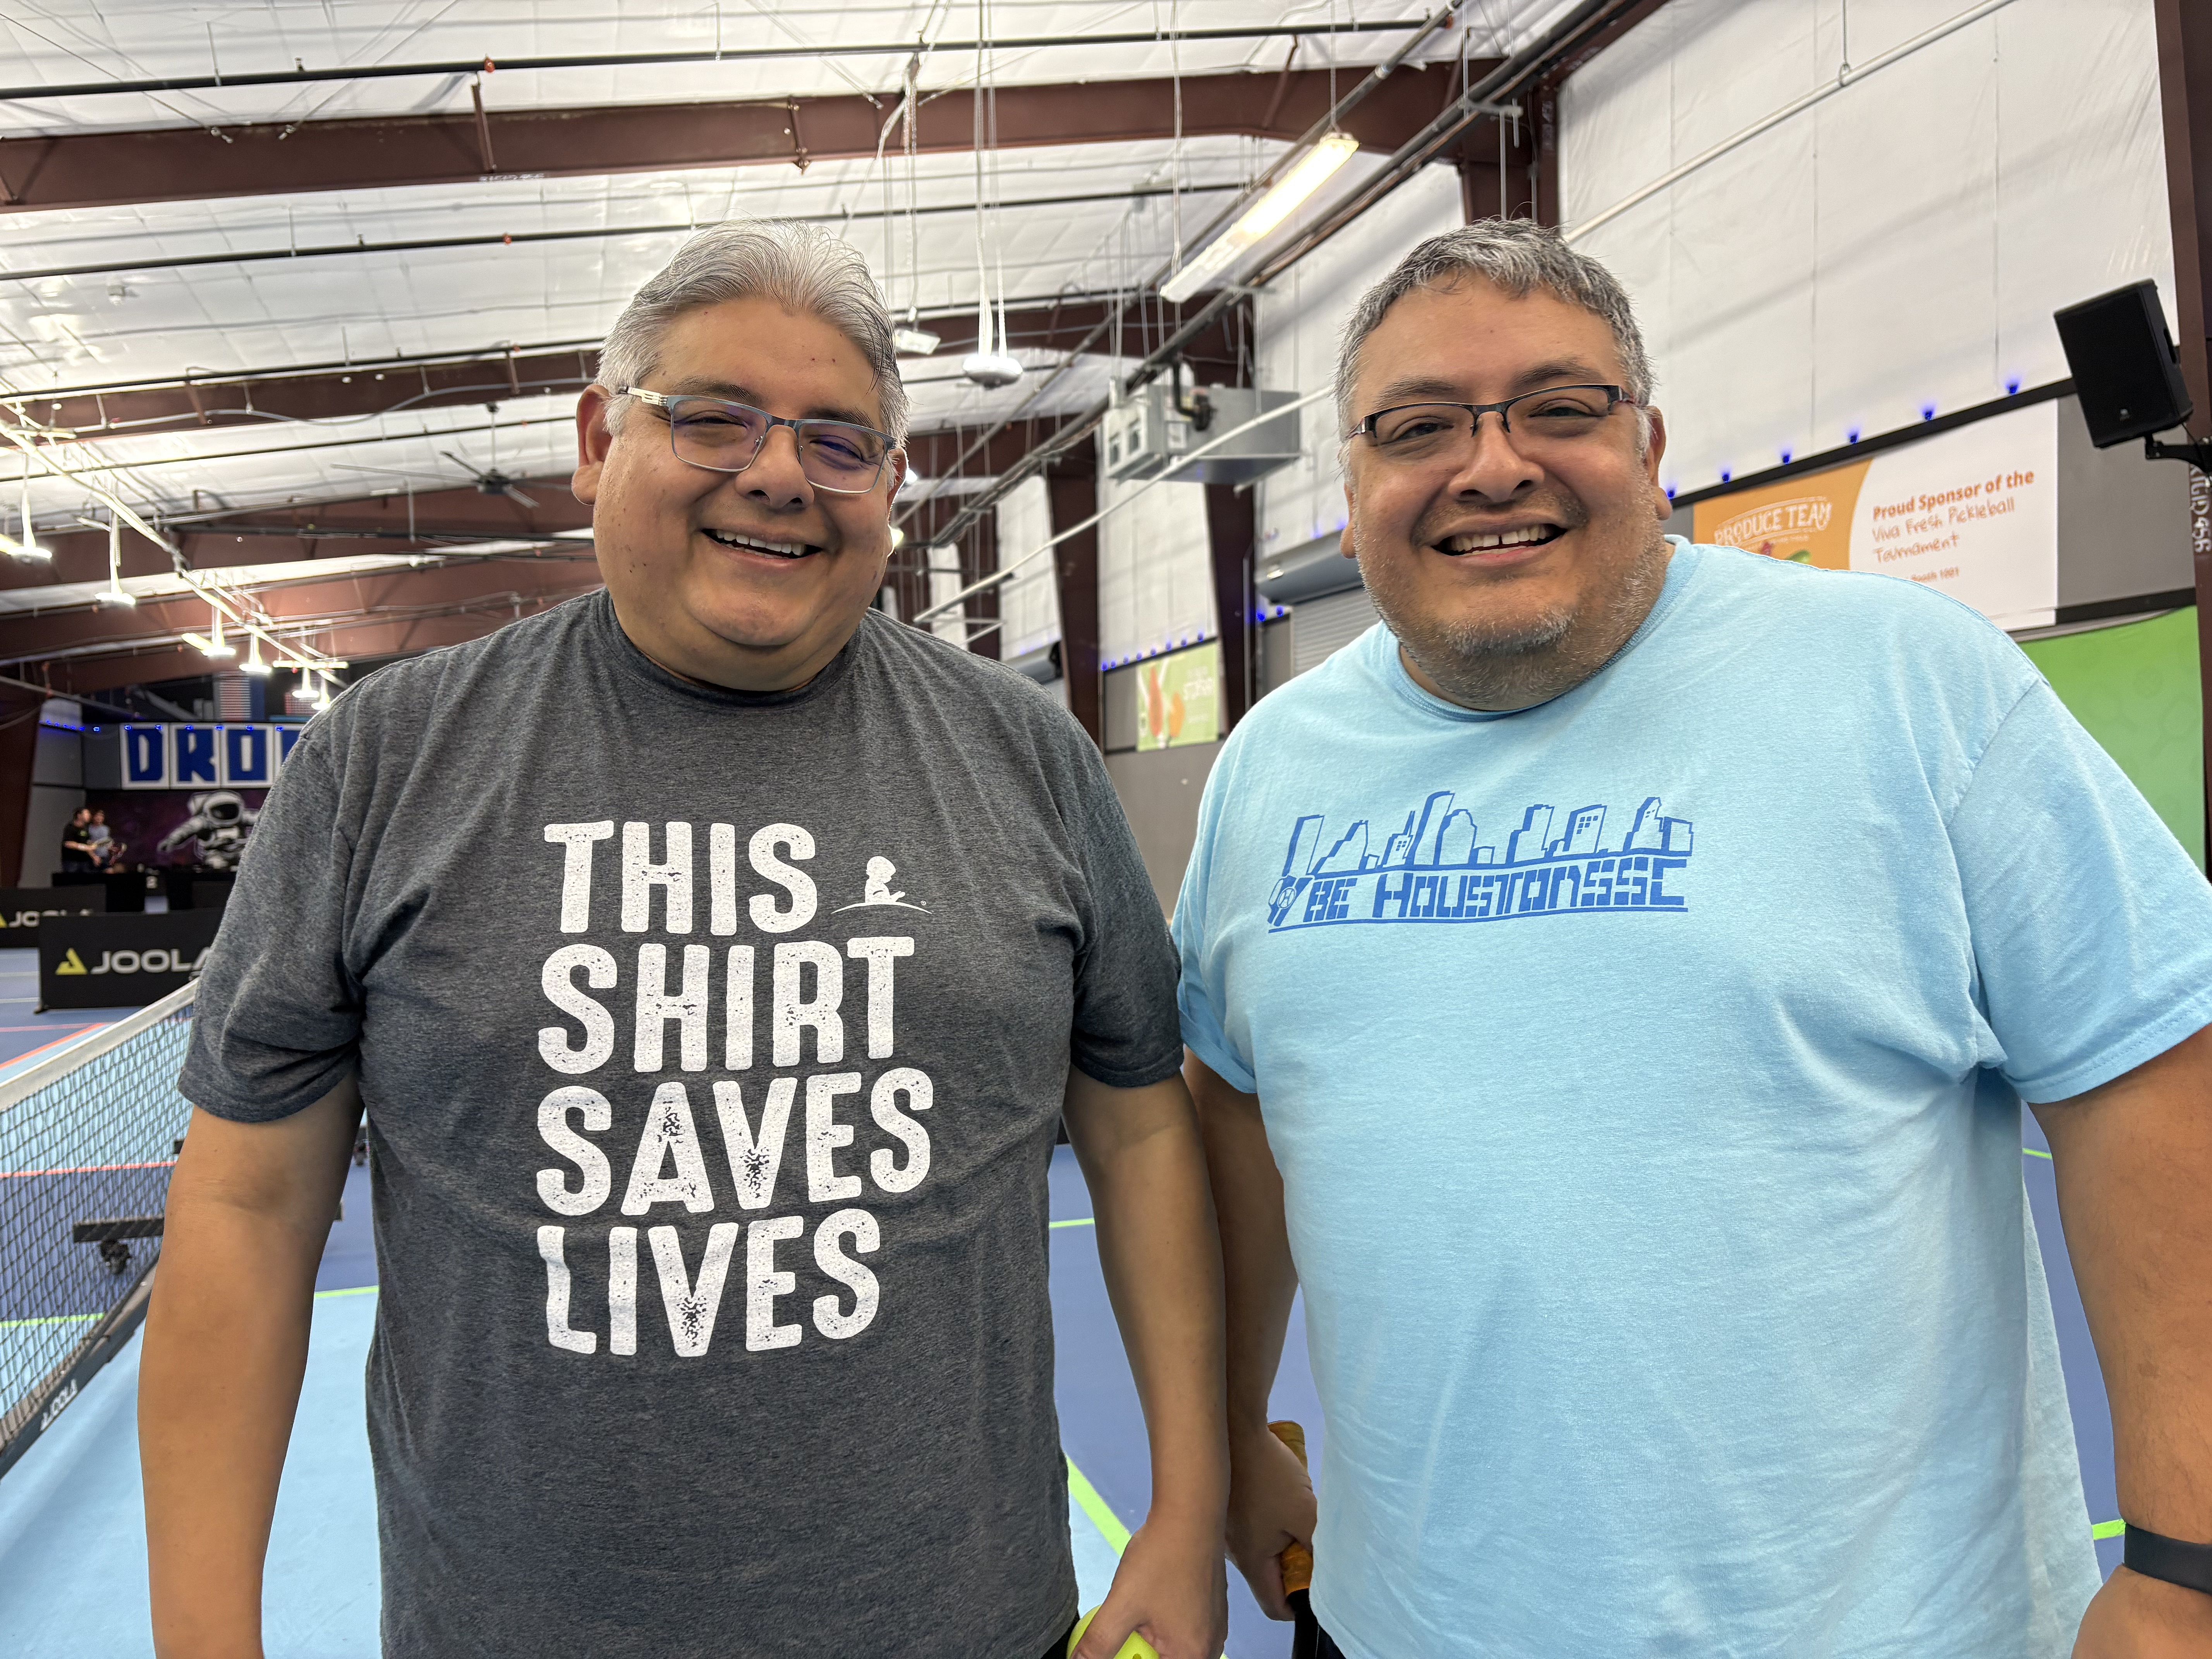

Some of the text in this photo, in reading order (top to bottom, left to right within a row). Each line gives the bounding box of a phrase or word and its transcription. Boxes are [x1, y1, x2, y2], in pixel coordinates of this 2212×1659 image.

[1872, 497, 2014, 542] Viva Fresh Pickleball
[1873, 471, 2034, 520] Proud Sponsor of the
[1714, 508, 1782, 545] PRODUCE
[1786, 502, 1832, 531] TEAM
[2192, 517, 2212, 553] 456
[127, 728, 301, 781] DRO
[544, 821, 817, 935] THIS
[1303, 878, 1357, 922] BE
[538, 936, 914, 1073] SHIRT
[536, 1067, 933, 1216] SAVES
[537, 1208, 880, 1357] LIVES
